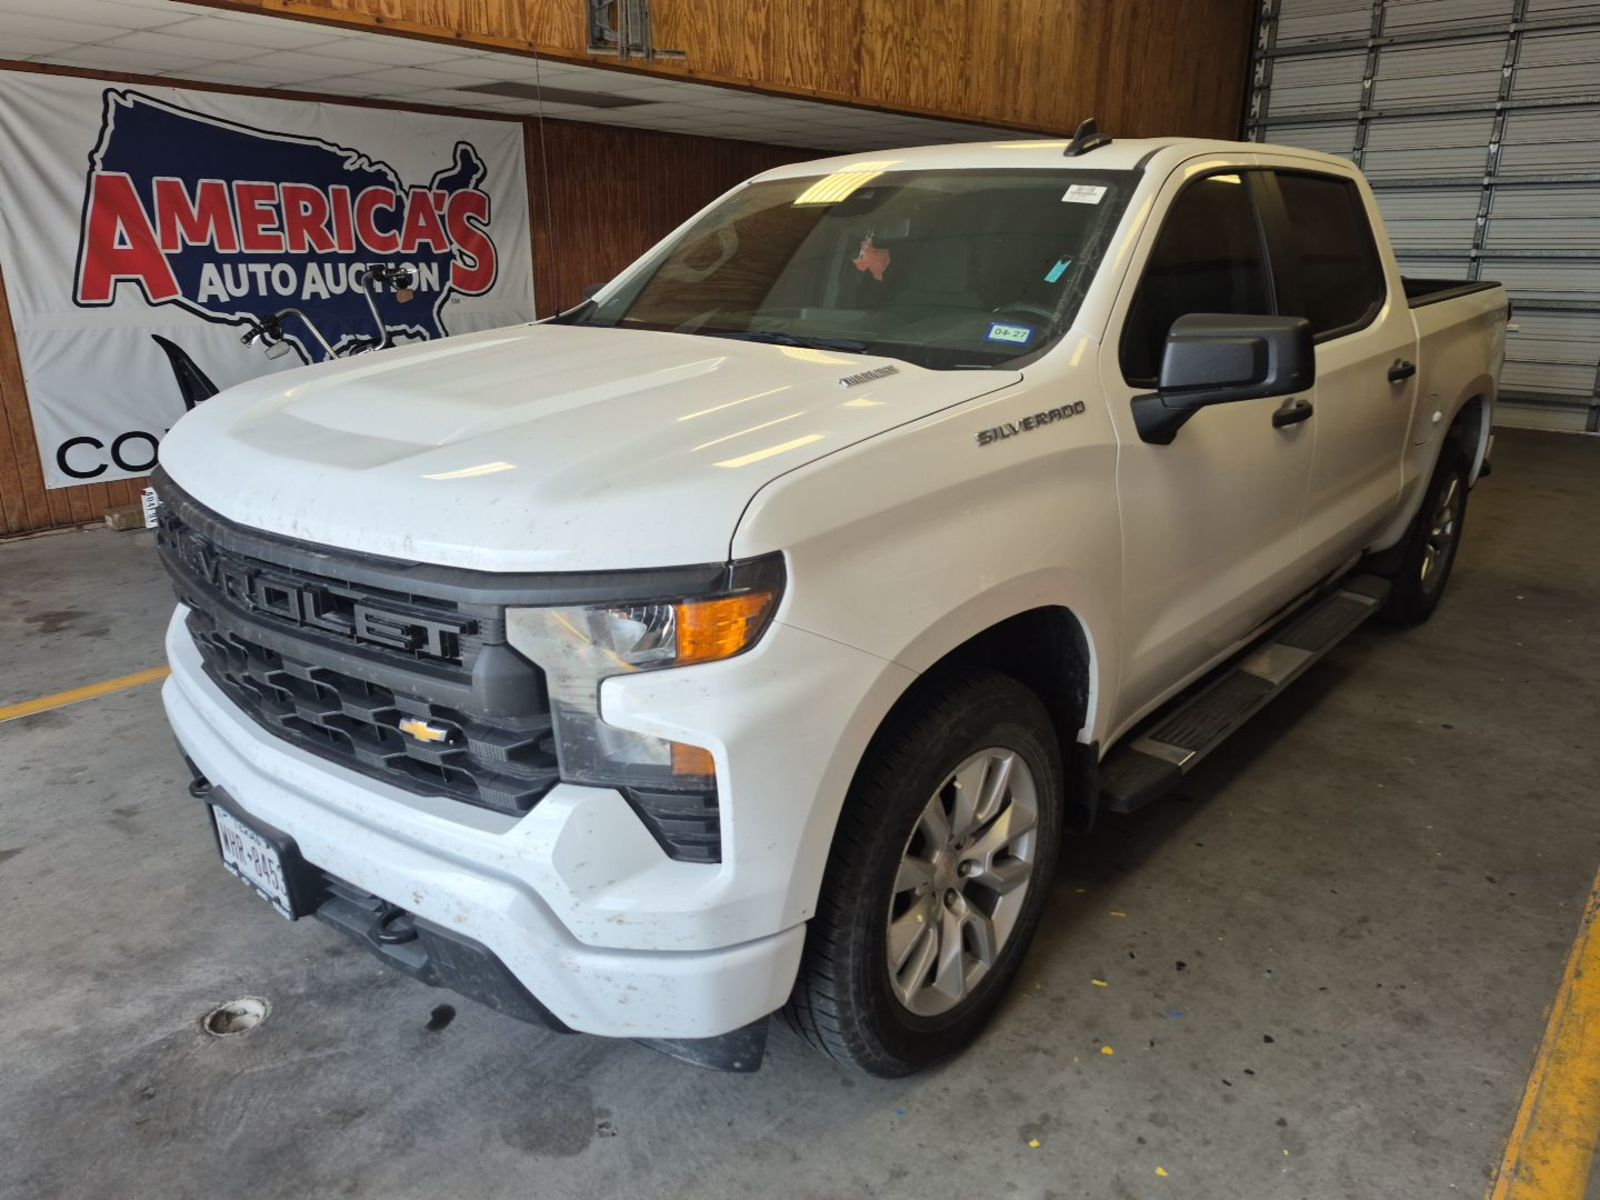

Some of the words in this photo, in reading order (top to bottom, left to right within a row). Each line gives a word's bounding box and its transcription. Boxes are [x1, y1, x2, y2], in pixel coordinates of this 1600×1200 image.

[78, 172, 496, 303] AMERICA'S
[198, 262, 298, 303] AUTO
[976, 400, 1086, 446] SILVERADO
